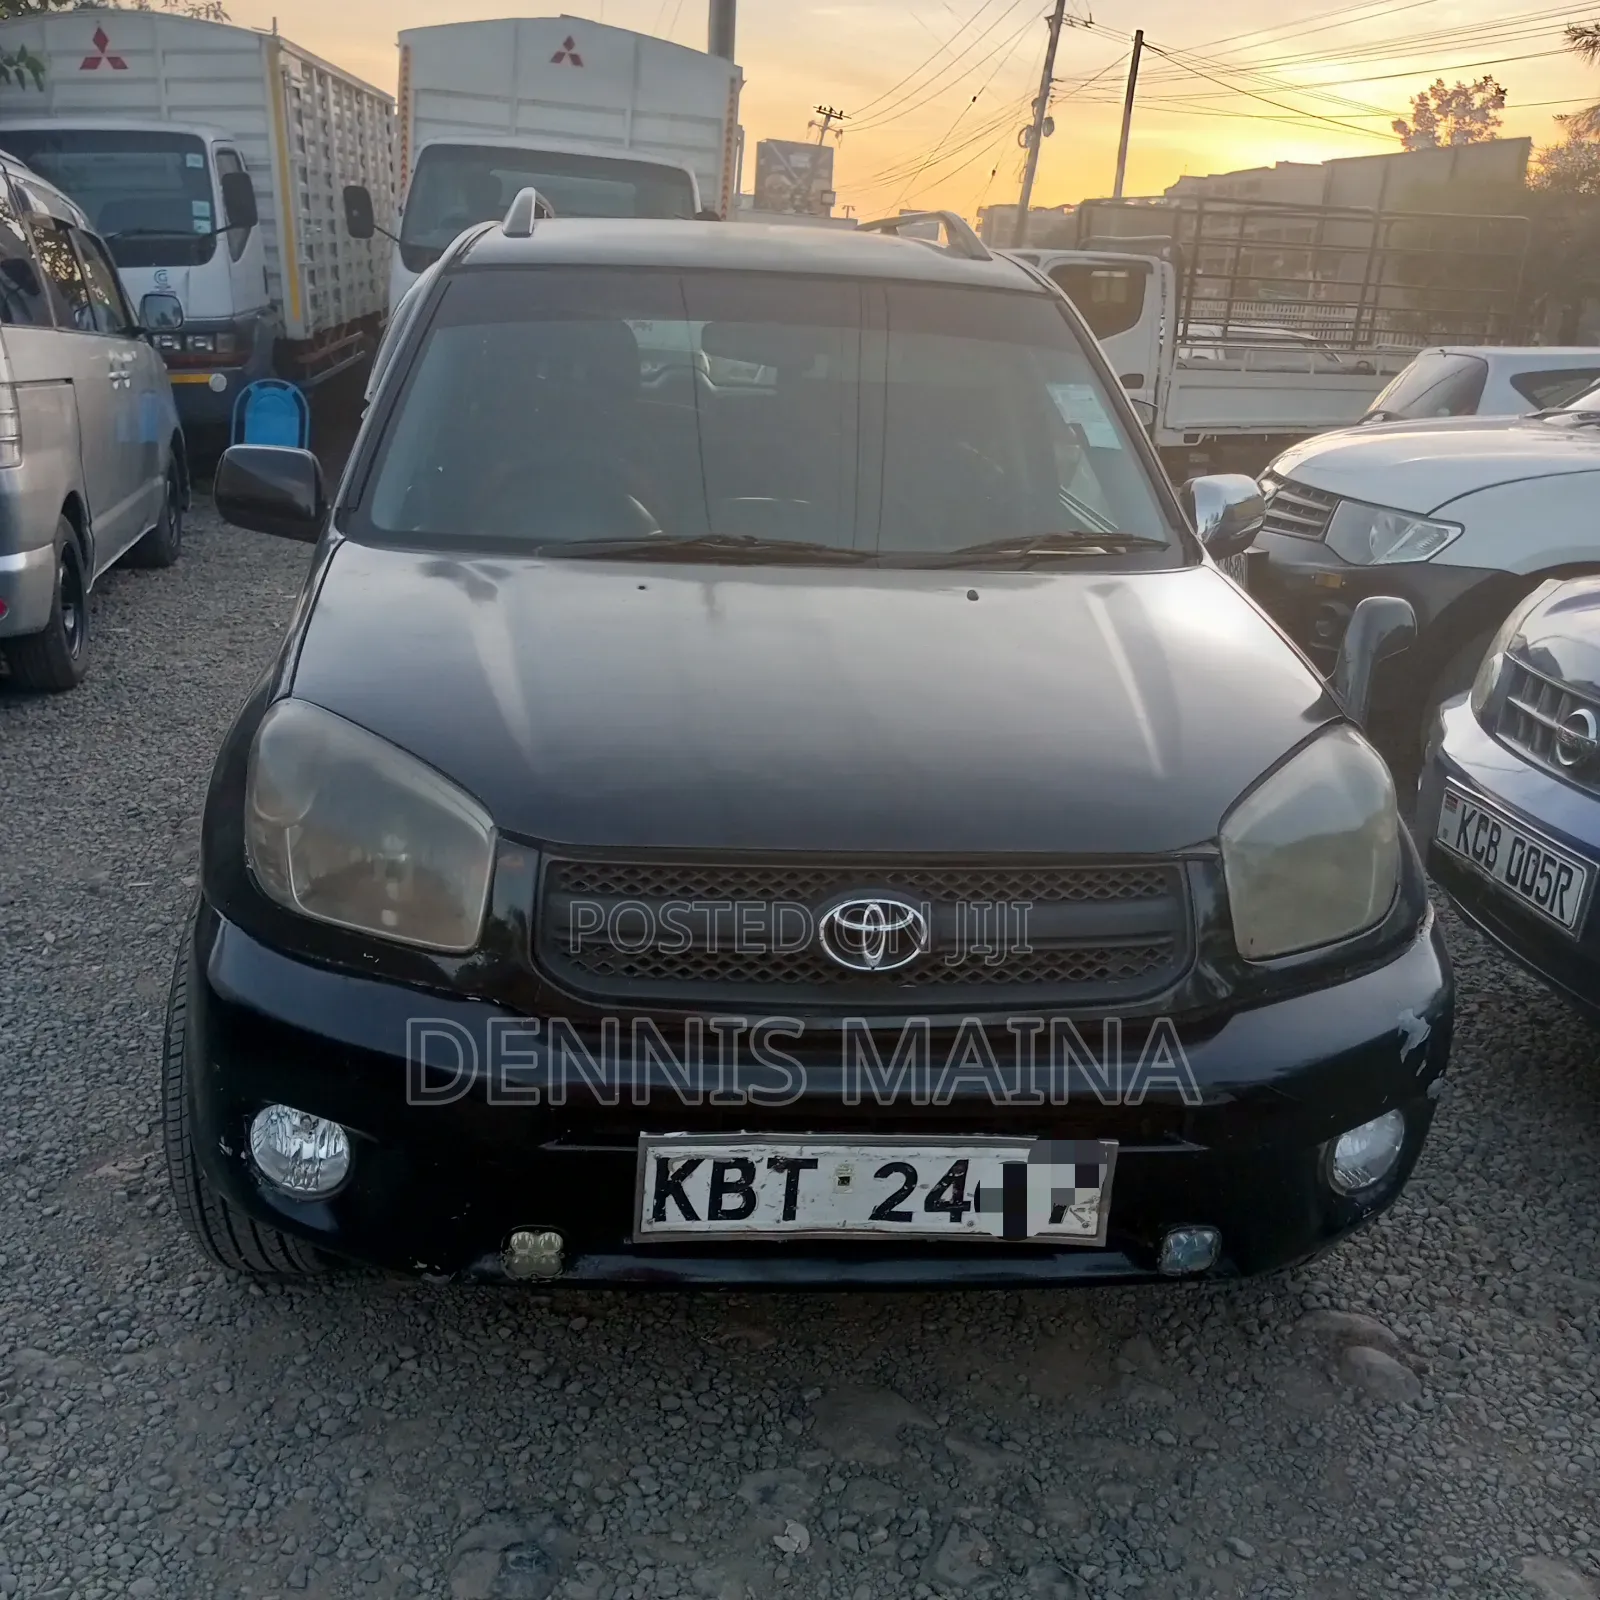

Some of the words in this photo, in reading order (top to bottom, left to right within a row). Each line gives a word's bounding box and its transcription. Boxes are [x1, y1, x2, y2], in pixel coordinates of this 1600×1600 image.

[1456, 804, 1502, 872] KCB
[1505, 836, 1574, 919] 005R
[653, 1156, 818, 1222] KBT
[868, 1158, 1088, 1225] 24
